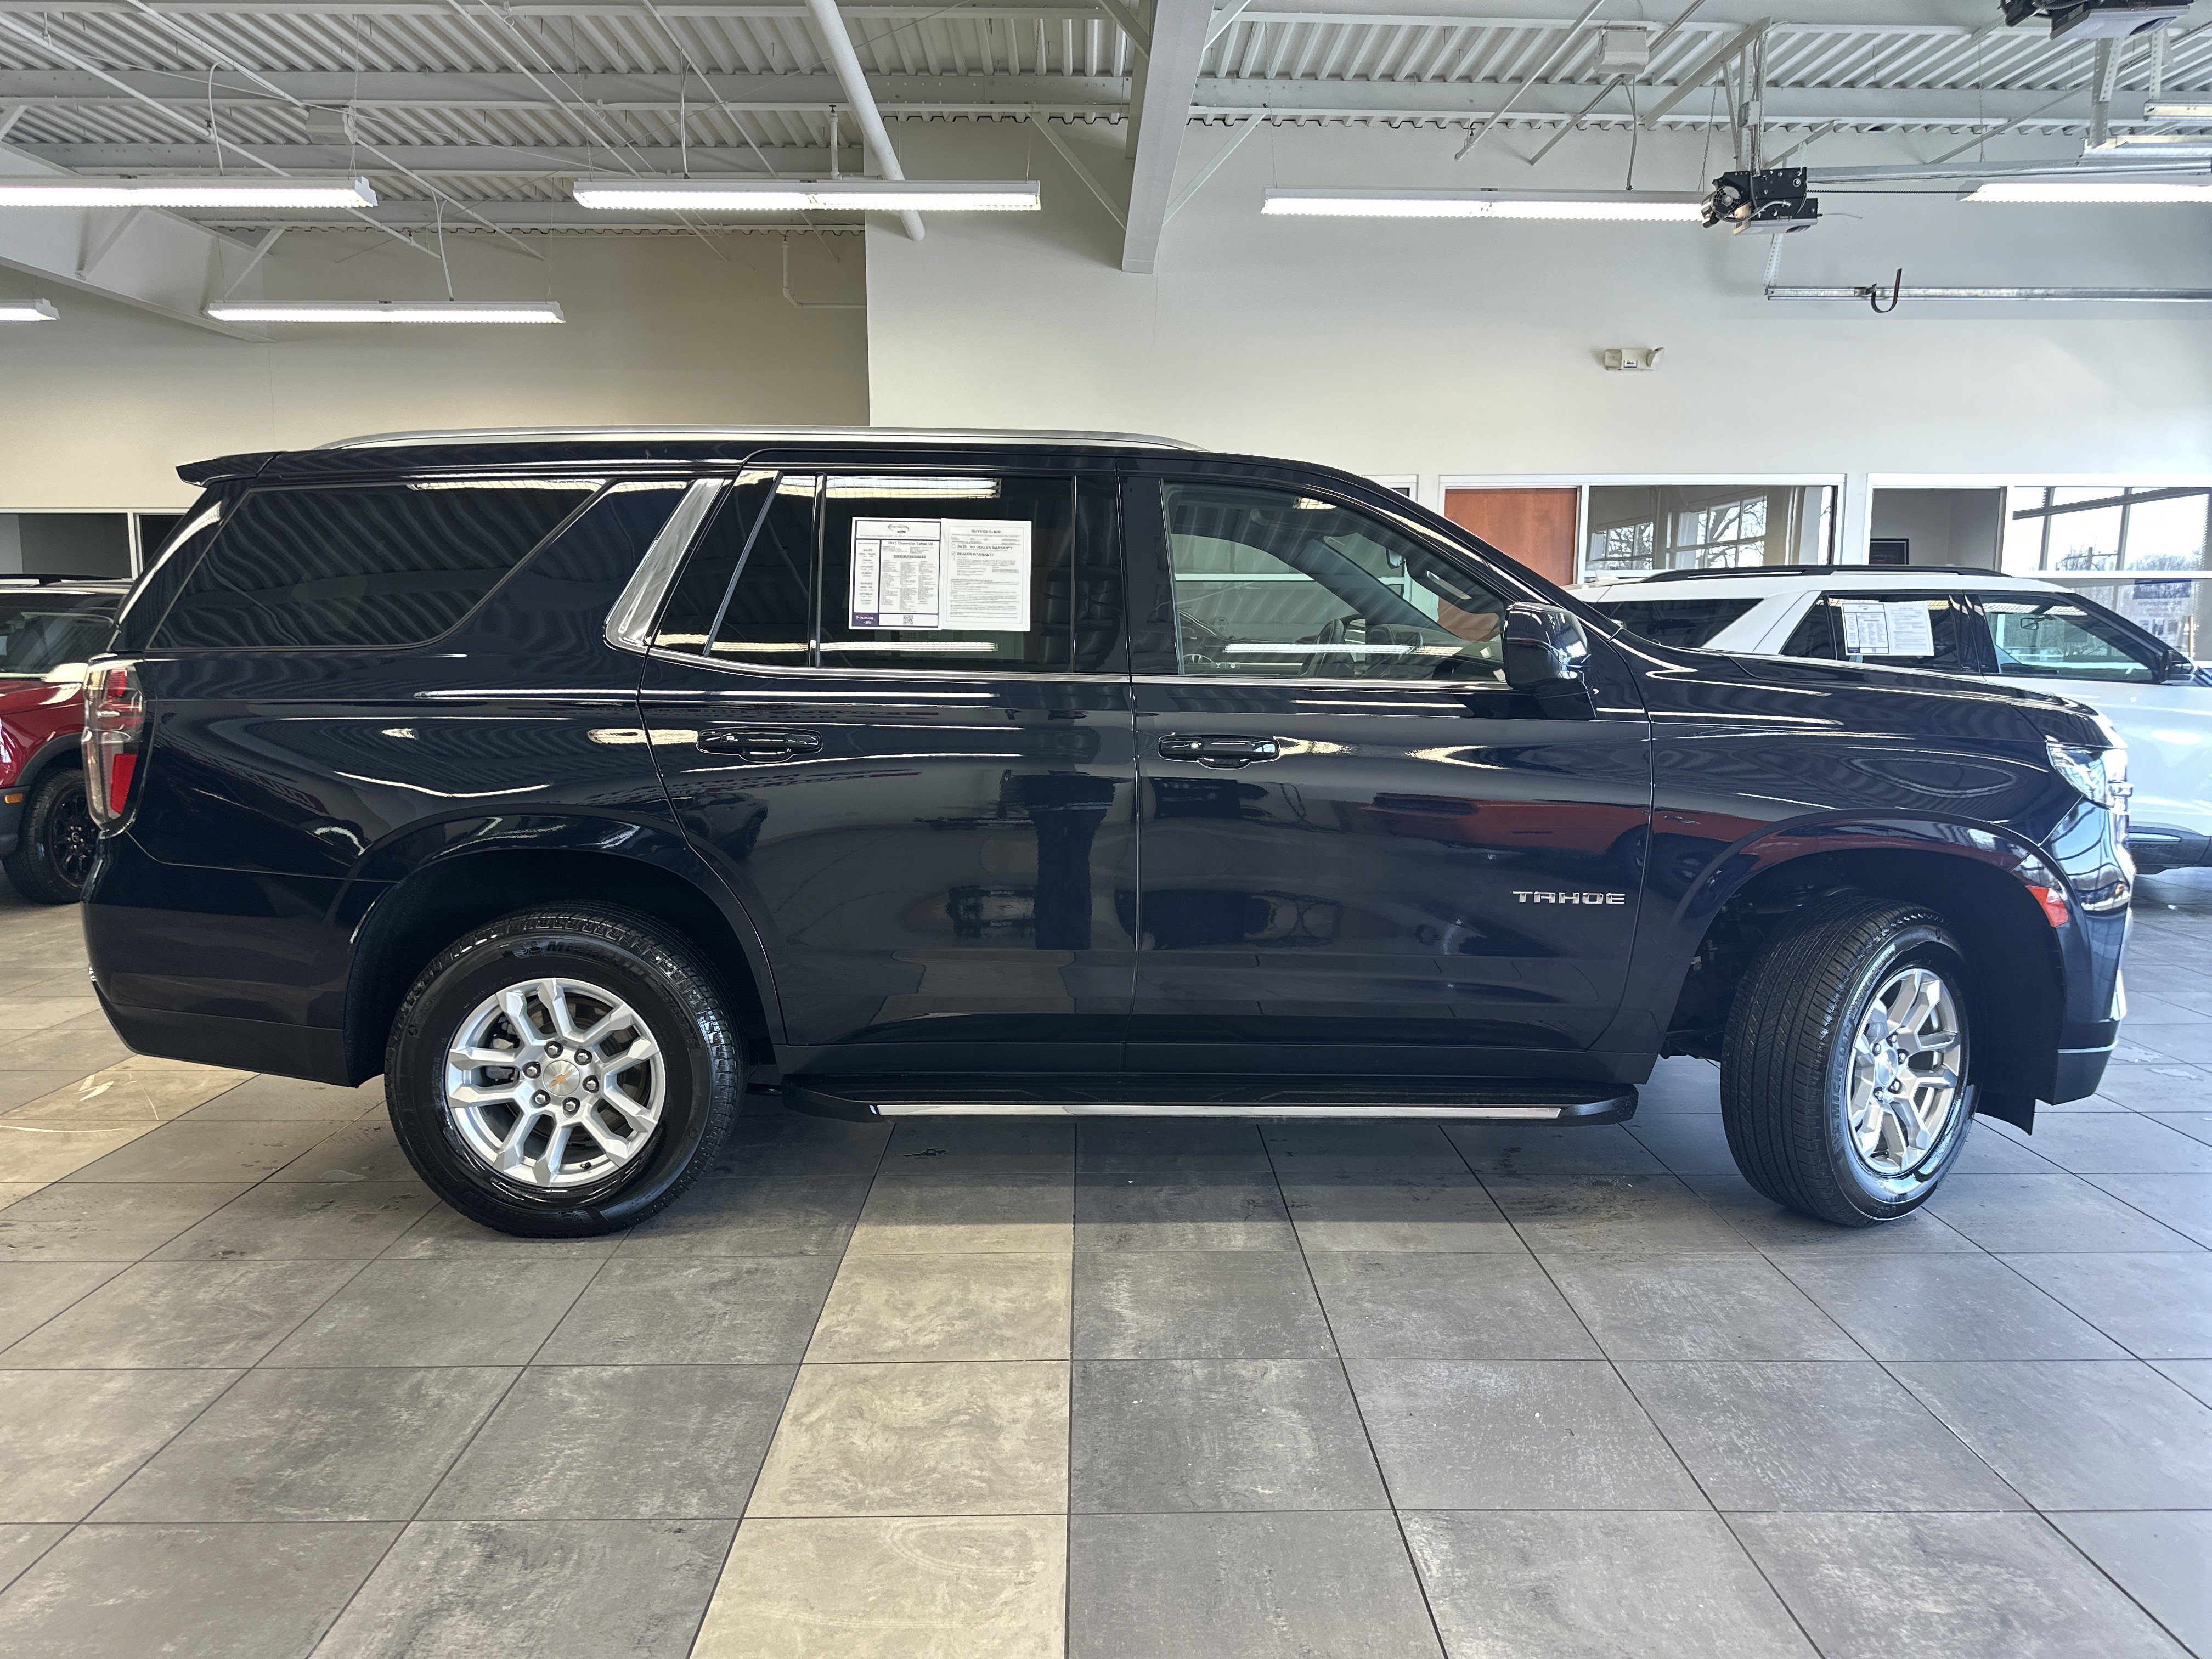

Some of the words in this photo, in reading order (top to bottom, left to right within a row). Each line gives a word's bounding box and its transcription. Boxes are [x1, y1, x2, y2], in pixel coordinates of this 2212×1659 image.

[1513, 891, 1626, 905] TAHOE
[546, 941, 645, 978] MICHELIN
[1831, 1019, 1854, 1120] MICHELIN
